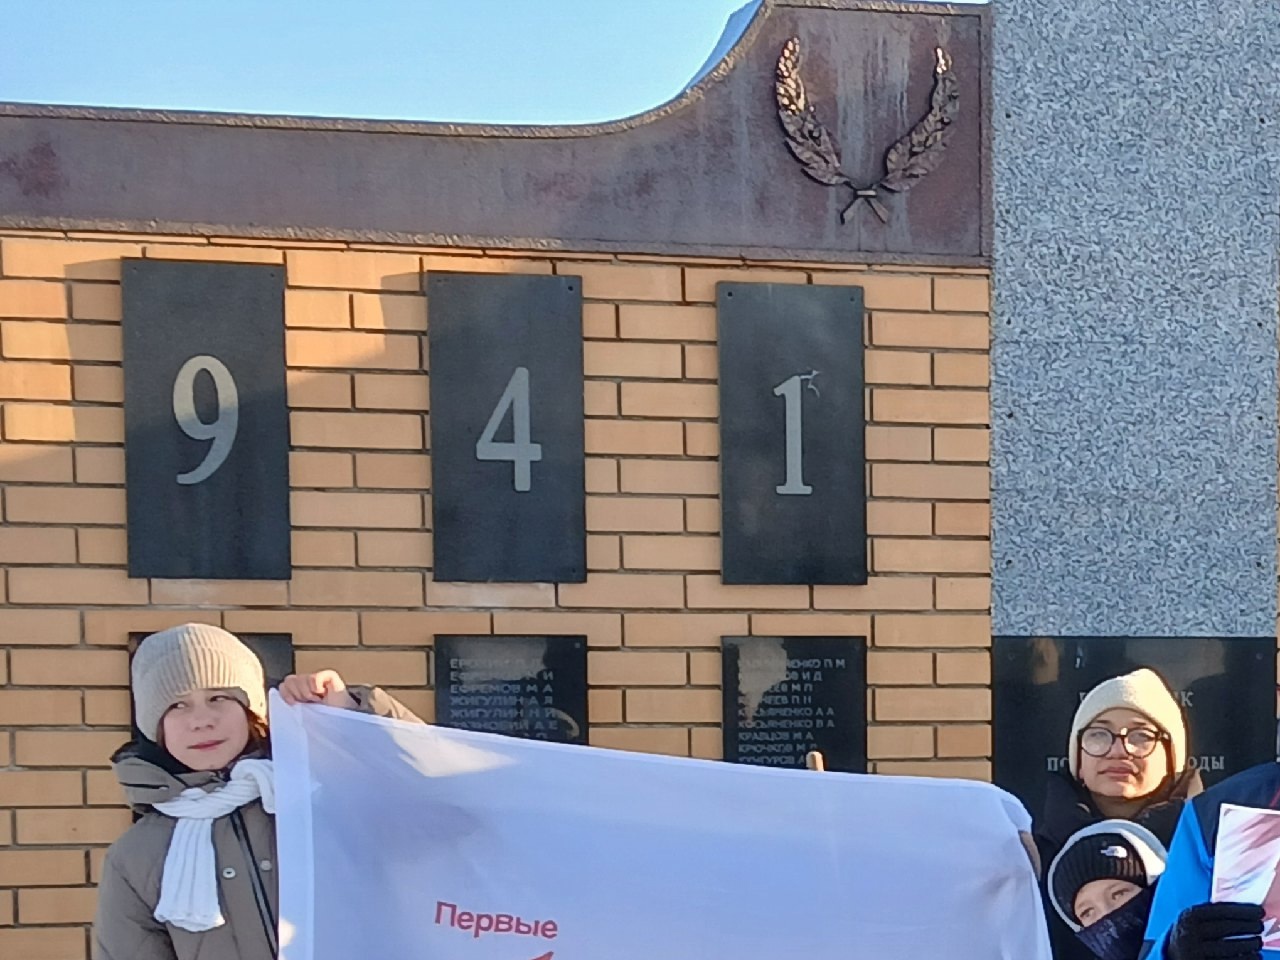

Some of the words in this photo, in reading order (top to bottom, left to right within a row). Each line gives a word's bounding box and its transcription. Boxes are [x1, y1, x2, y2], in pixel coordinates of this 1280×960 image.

[173, 355, 239, 485] 9
[475, 366, 542, 492] 4
[773, 375, 813, 495] 1
[434, 901, 559, 939] Первые
